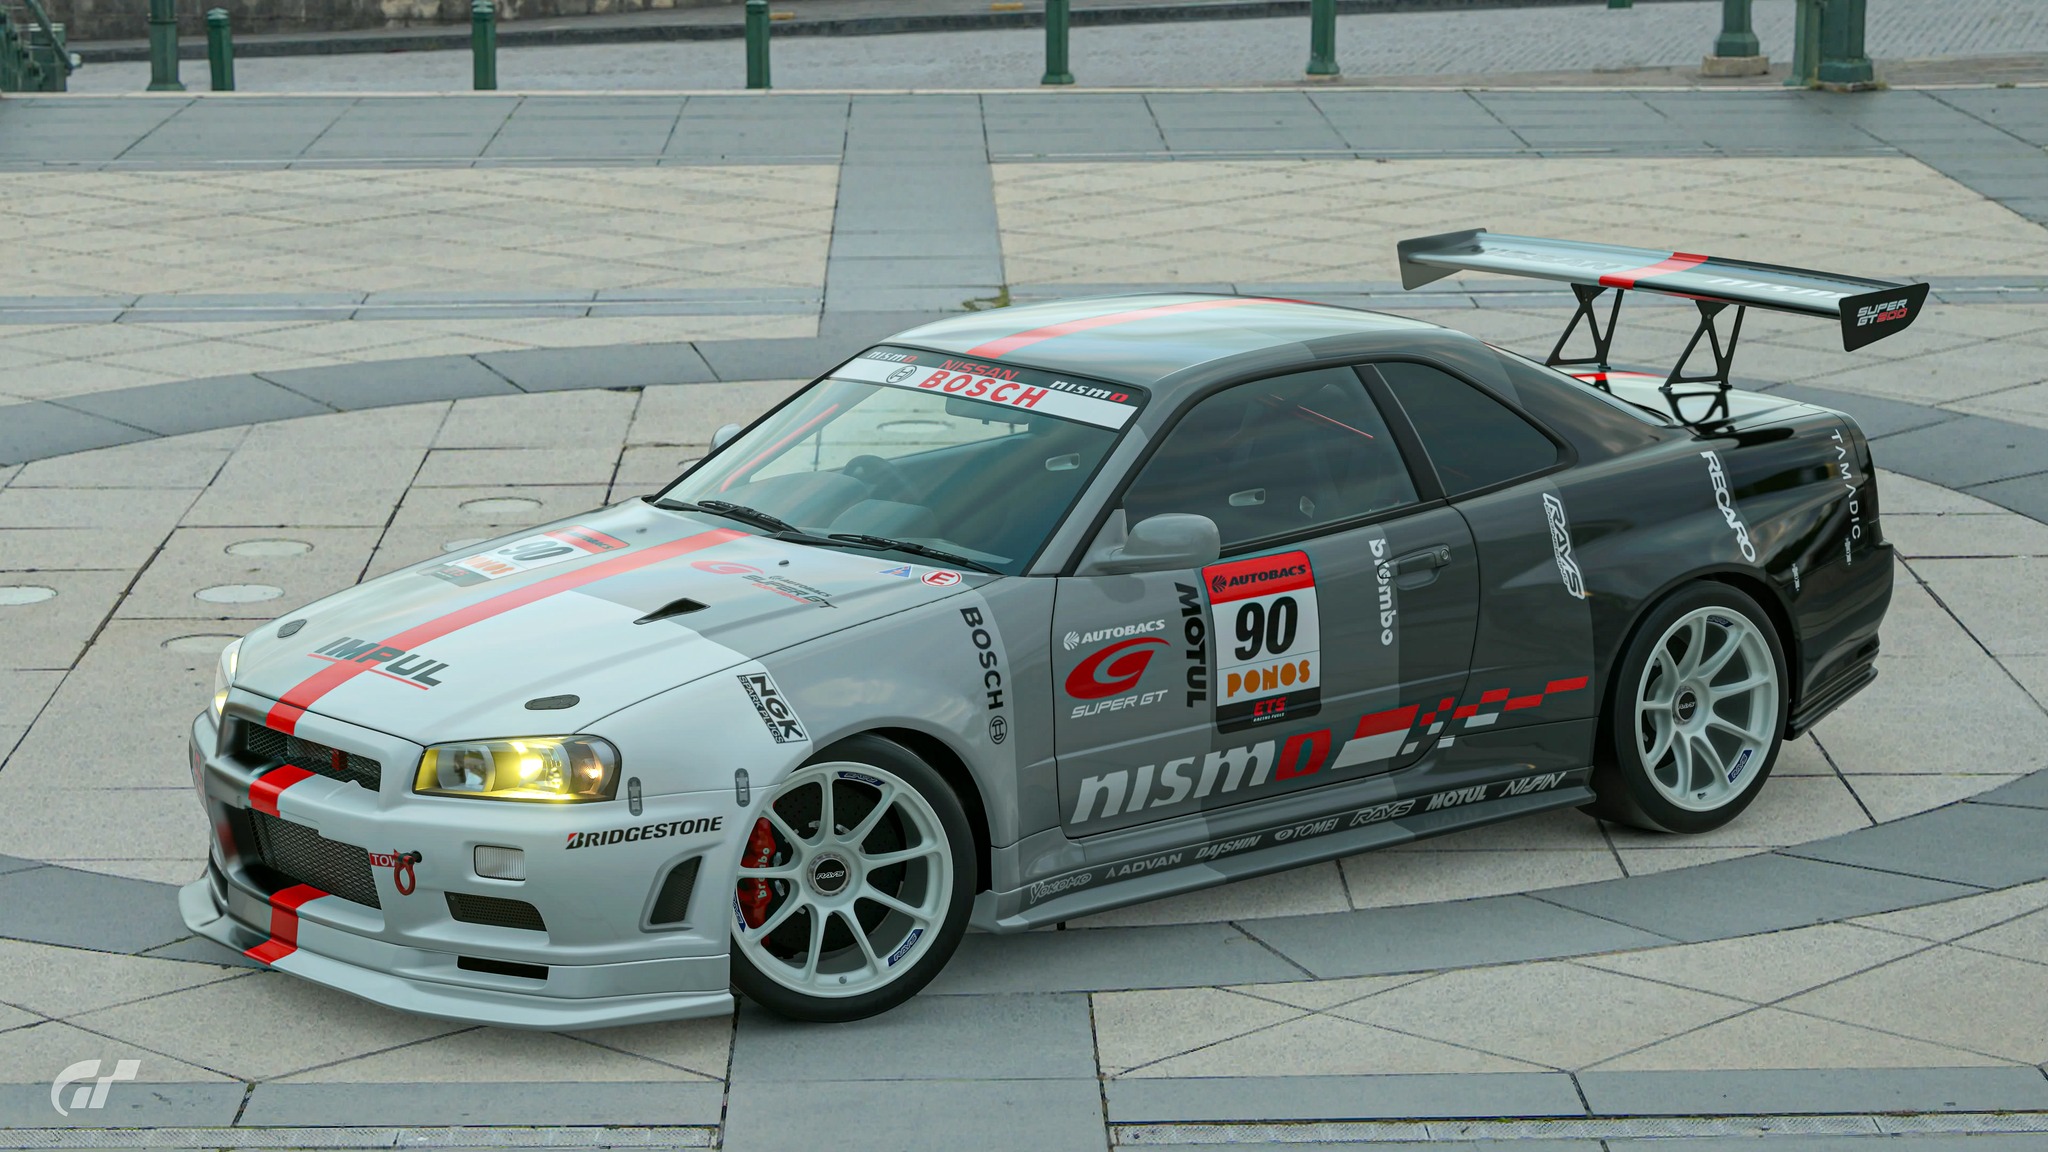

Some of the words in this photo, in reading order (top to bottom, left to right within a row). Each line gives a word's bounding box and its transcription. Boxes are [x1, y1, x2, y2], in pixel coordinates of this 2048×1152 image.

[1857, 298, 1908, 318] SUPER
[1857, 308, 1908, 327] GT500
[866, 350, 917, 364] nismo
[938, 359, 1021, 382] NISSAN
[918, 370, 1049, 409] BOSCH
[1050, 379, 1130, 404] nismo
[1830, 429, 1861, 540] TAMADIC
[1700, 450, 1756, 563] RECARO
[497, 540, 575, 562] 90
[1542, 493, 1585, 600] RAYS
[1228, 564, 1307, 587] AUTOBACS
[1081, 619, 1166, 644] AUTOBACS
[1234, 596, 1298, 661] 90
[959, 606, 1004, 710] BOSCH
[1174, 582, 1207, 708] MOTUL
[313, 636, 450, 687] IMPUL
[1227, 659, 1311, 698] PONOS
[739, 675, 764, 708] SPARK
[759, 709, 784, 743] PLUGS
[749, 675, 804, 740] NGK
[1070, 697, 1137, 720] SUPER
[1139, 689, 1169, 706] GT
[1253, 697, 1287, 716] ETS
[1070, 728, 1332, 825] nismo
[1349, 799, 1416, 827] RAYS
[1425, 785, 1487, 811] MOTUL
[566, 816, 723, 850] BRIDGESTONE
[1293, 817, 1338, 839] TOMEI
[816, 870, 845, 880] RAYS
[1117, 853, 1182, 877] ADVAN
[1030, 872, 1092, 905] YOKOMO
[893, 932, 918, 962] RAYS
